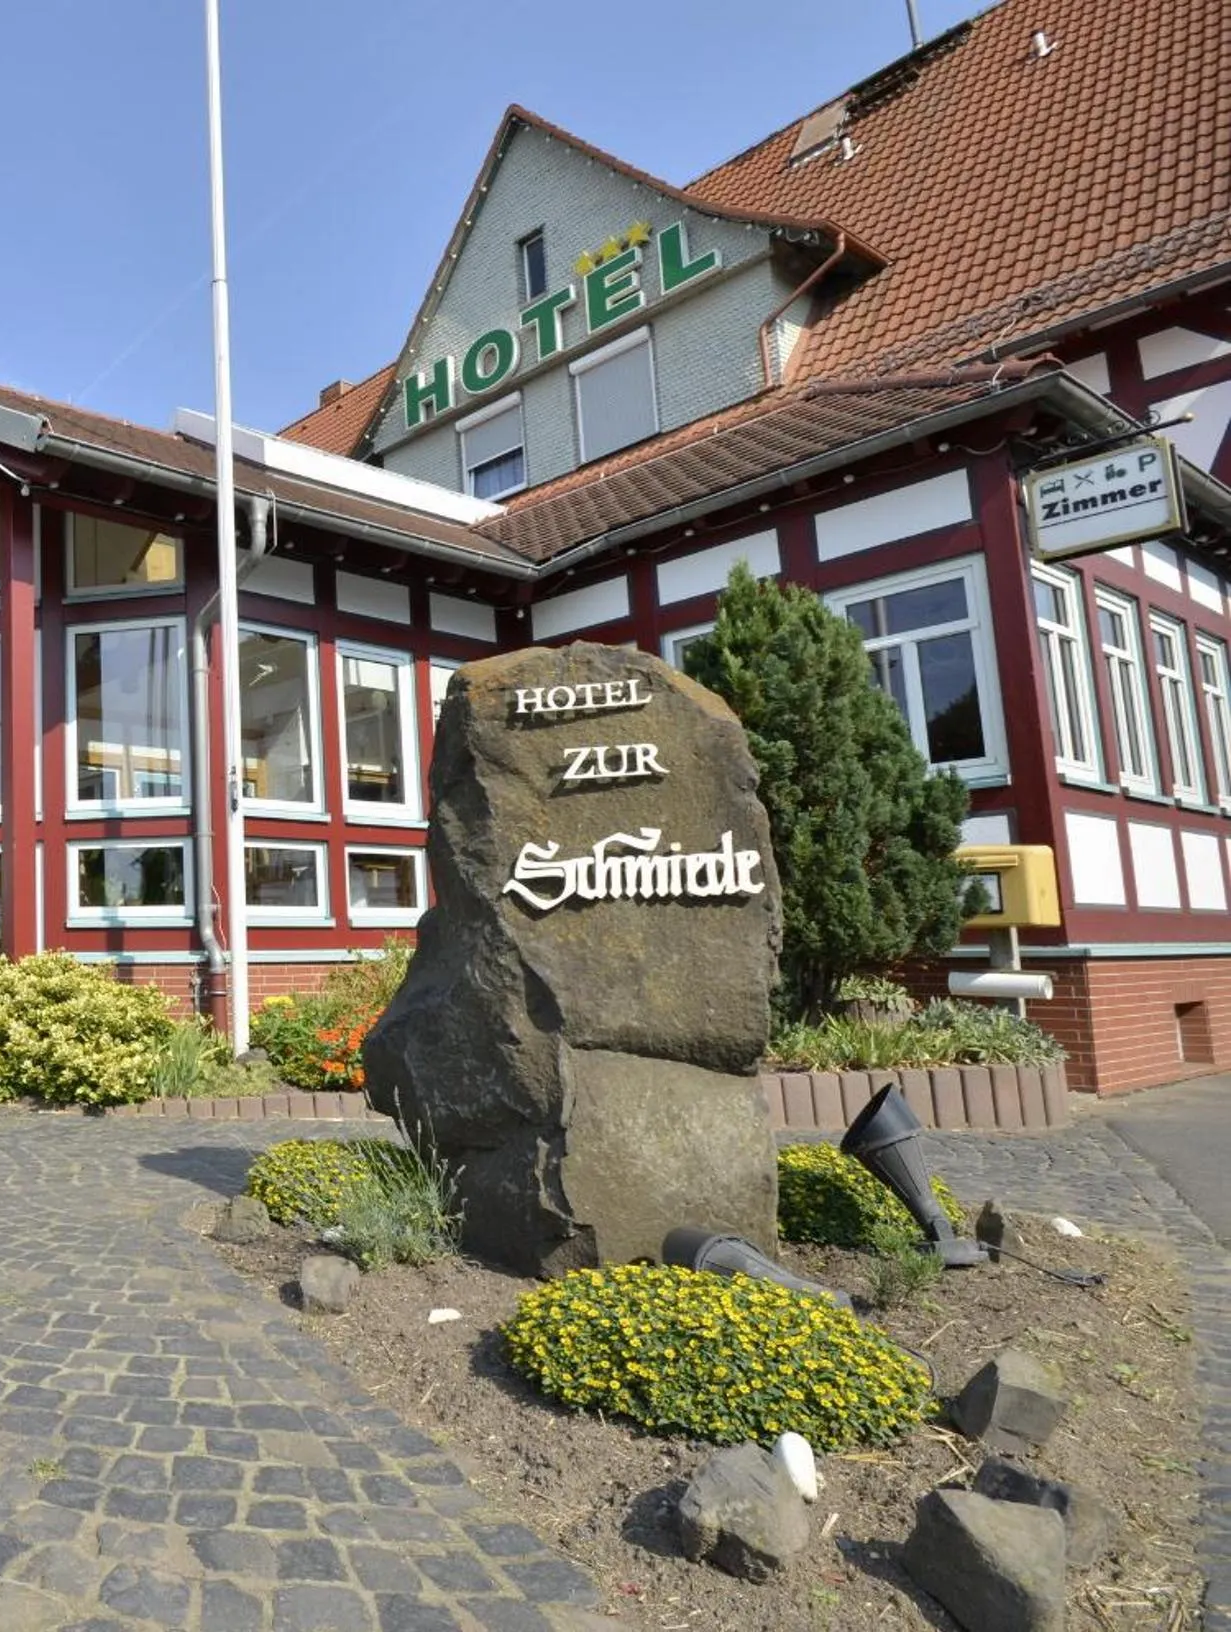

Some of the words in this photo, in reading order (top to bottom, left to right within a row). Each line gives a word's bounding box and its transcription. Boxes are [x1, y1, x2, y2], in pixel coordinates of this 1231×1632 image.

[404, 221, 722, 430] HOTEL
[1042, 478, 1163, 522] Zimmer
[515, 679, 652, 714] HOTEL
[563, 743, 669, 780] ZUR
[502, 827, 765, 911] Schmiede
